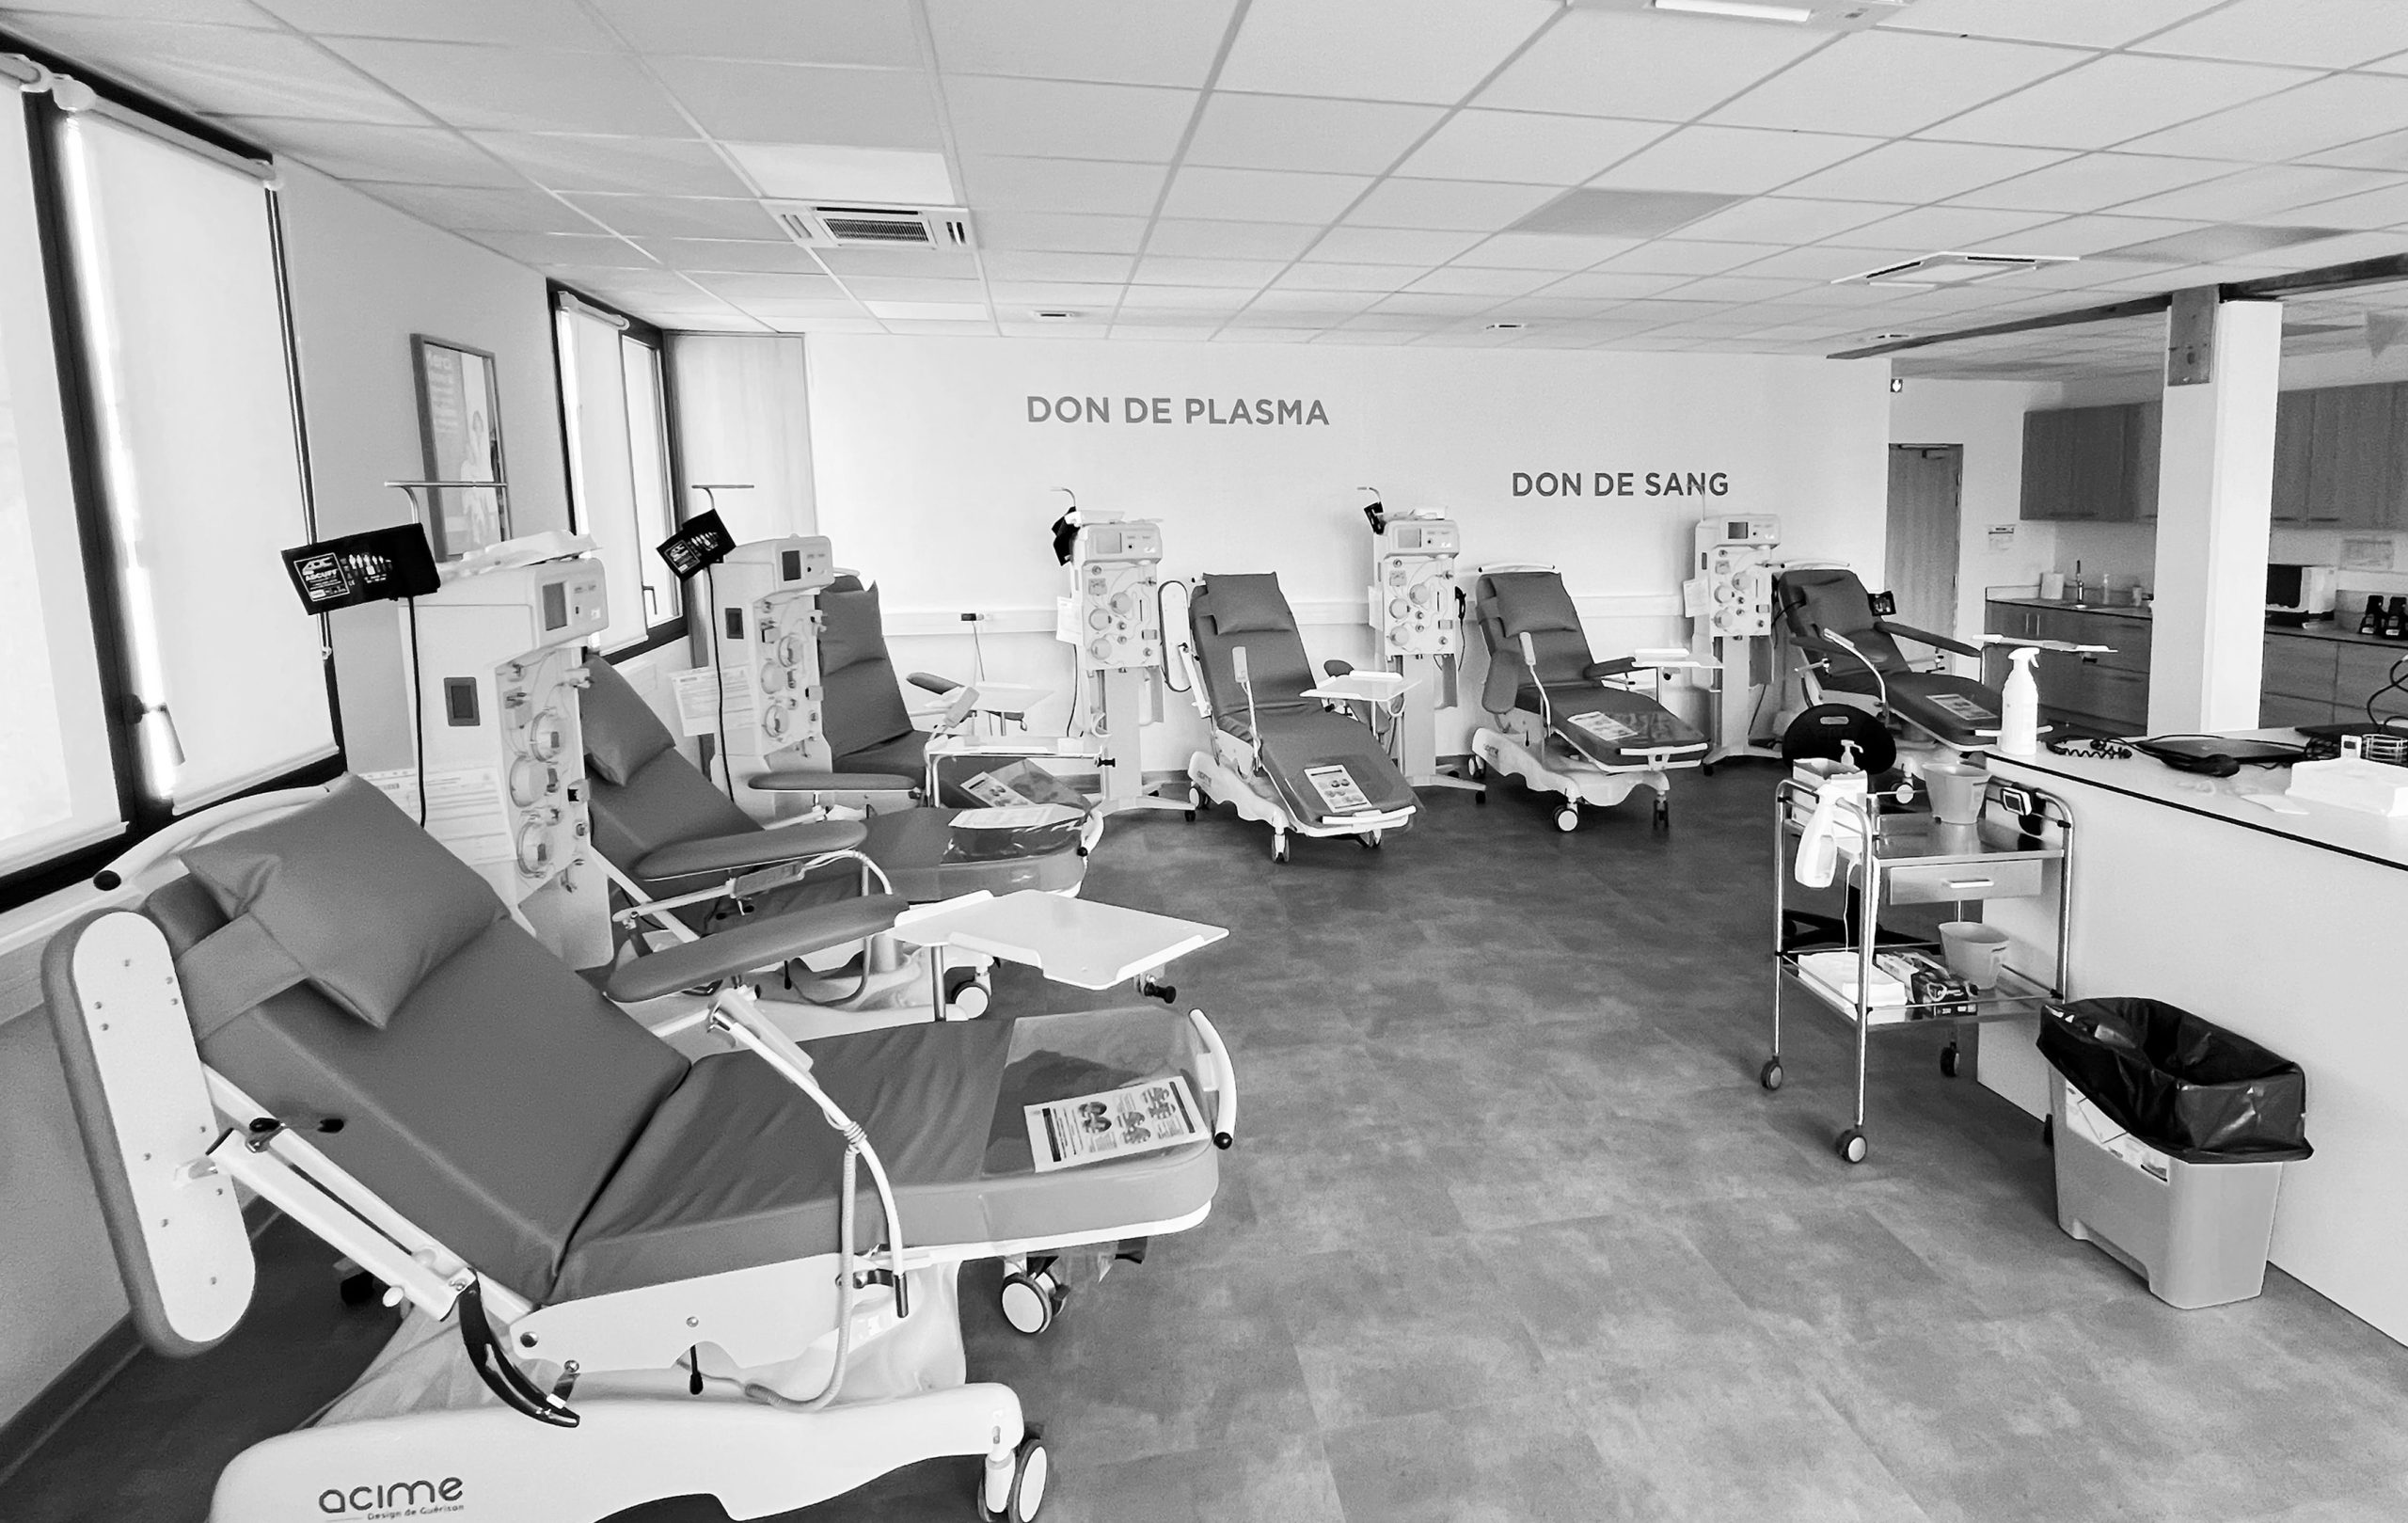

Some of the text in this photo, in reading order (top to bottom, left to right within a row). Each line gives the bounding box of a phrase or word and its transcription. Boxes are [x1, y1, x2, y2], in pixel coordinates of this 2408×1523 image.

[1027, 396, 1330, 425] DON DE PLASMA
[1512, 472, 1729, 497] DON DE SANG
[319, 1476, 463, 1514] acime
[367, 1511, 402, 1521] Design
